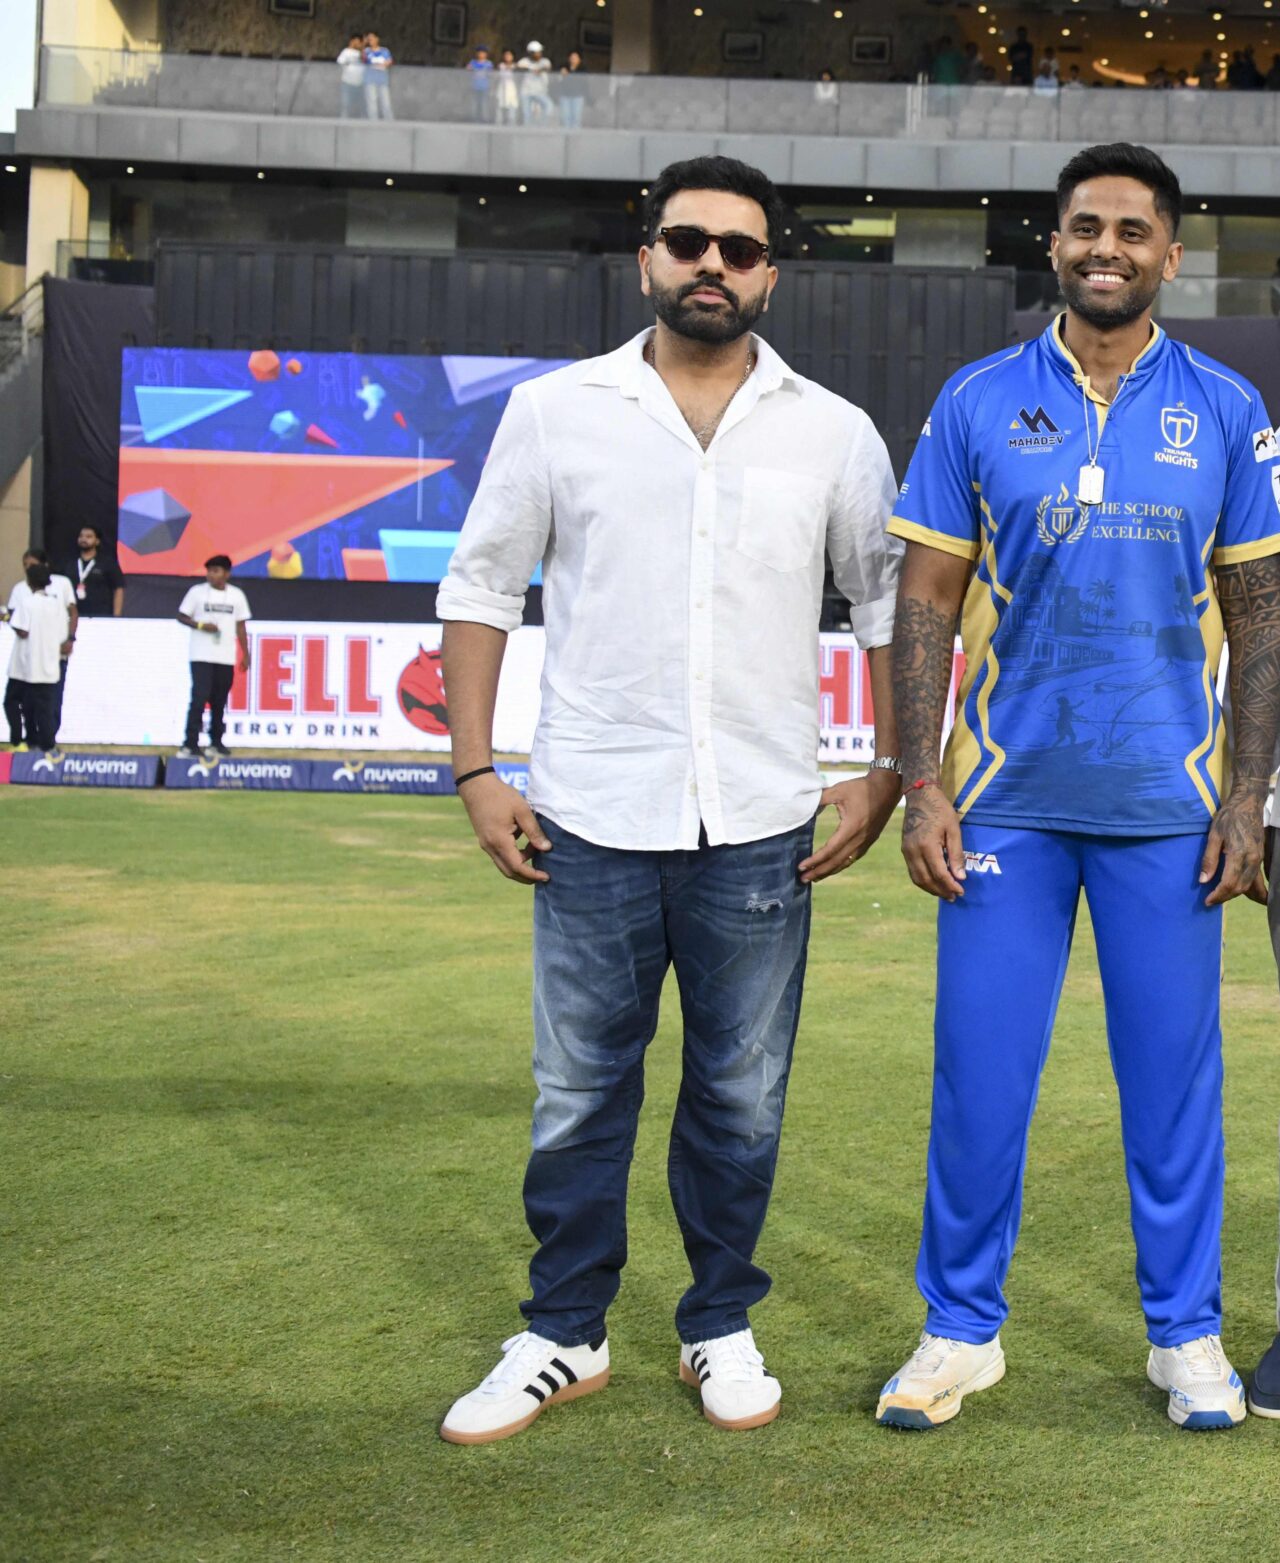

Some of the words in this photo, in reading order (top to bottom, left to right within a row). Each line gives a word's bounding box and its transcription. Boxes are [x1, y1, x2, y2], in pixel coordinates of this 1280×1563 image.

[1008, 436, 1064, 448] MAHADEV
[1154, 451, 1199, 469] KNIGHTS
[1123, 502, 1185, 521] SCHOOL
[307, 724, 381, 738] DRINK
[64, 760, 138, 775] nuvama
[219, 764, 293, 778] nuvama
[364, 768, 438, 782] nuvama
